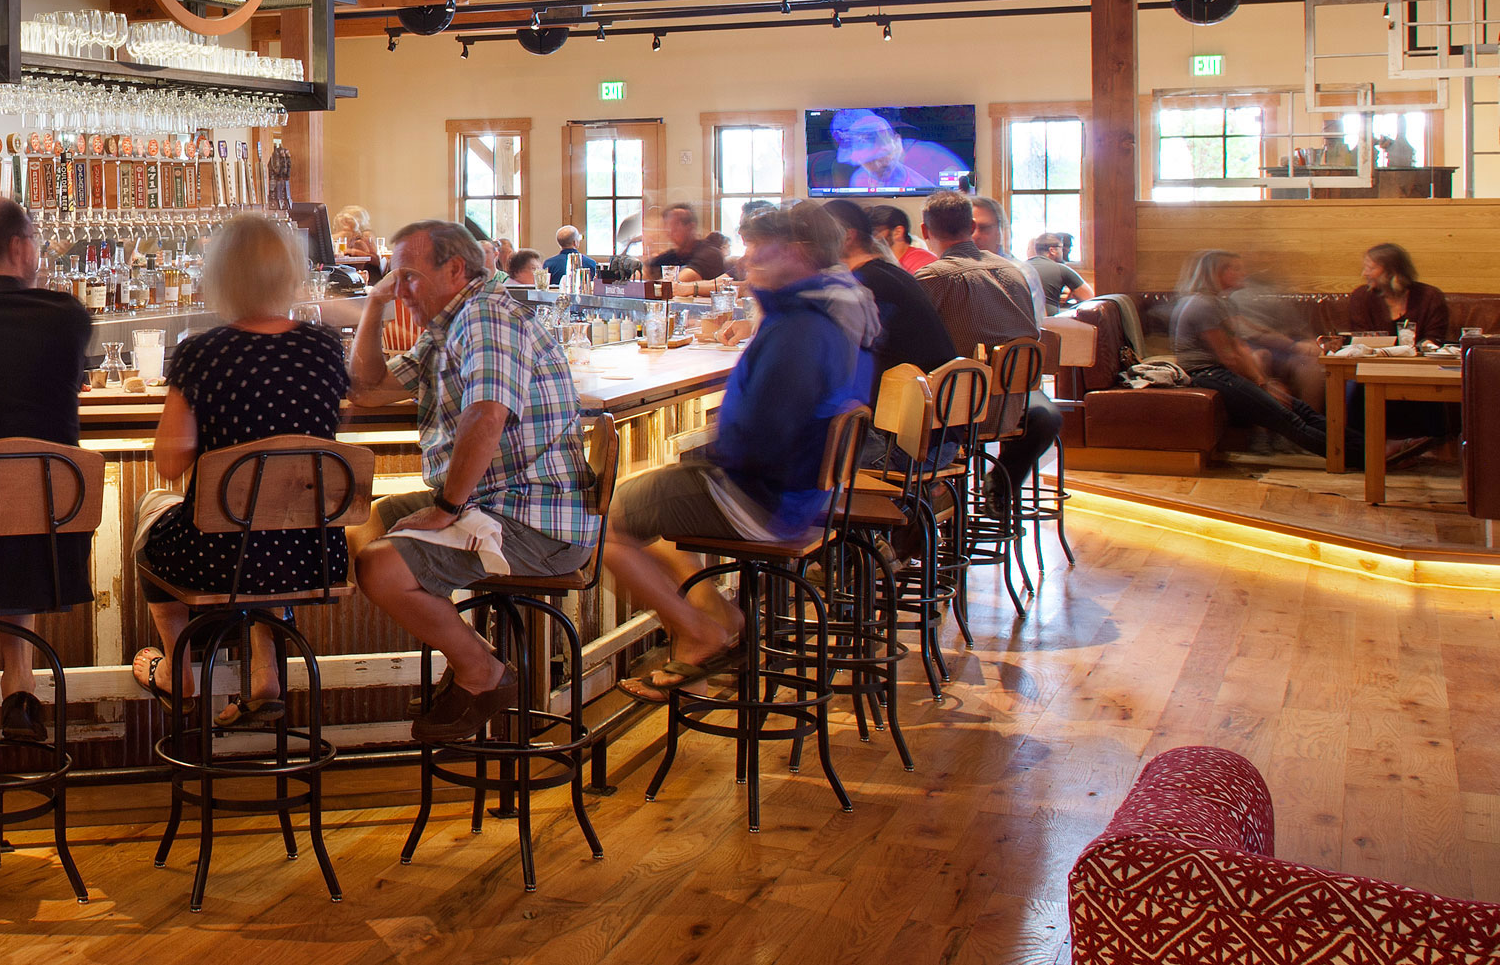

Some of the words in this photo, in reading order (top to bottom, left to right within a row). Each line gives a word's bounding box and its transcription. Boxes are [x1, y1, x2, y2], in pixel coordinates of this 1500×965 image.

[1194, 56, 1221, 75] EXIT
[602, 82, 623, 100] EXIT
[148, 166, 156, 188] 471
